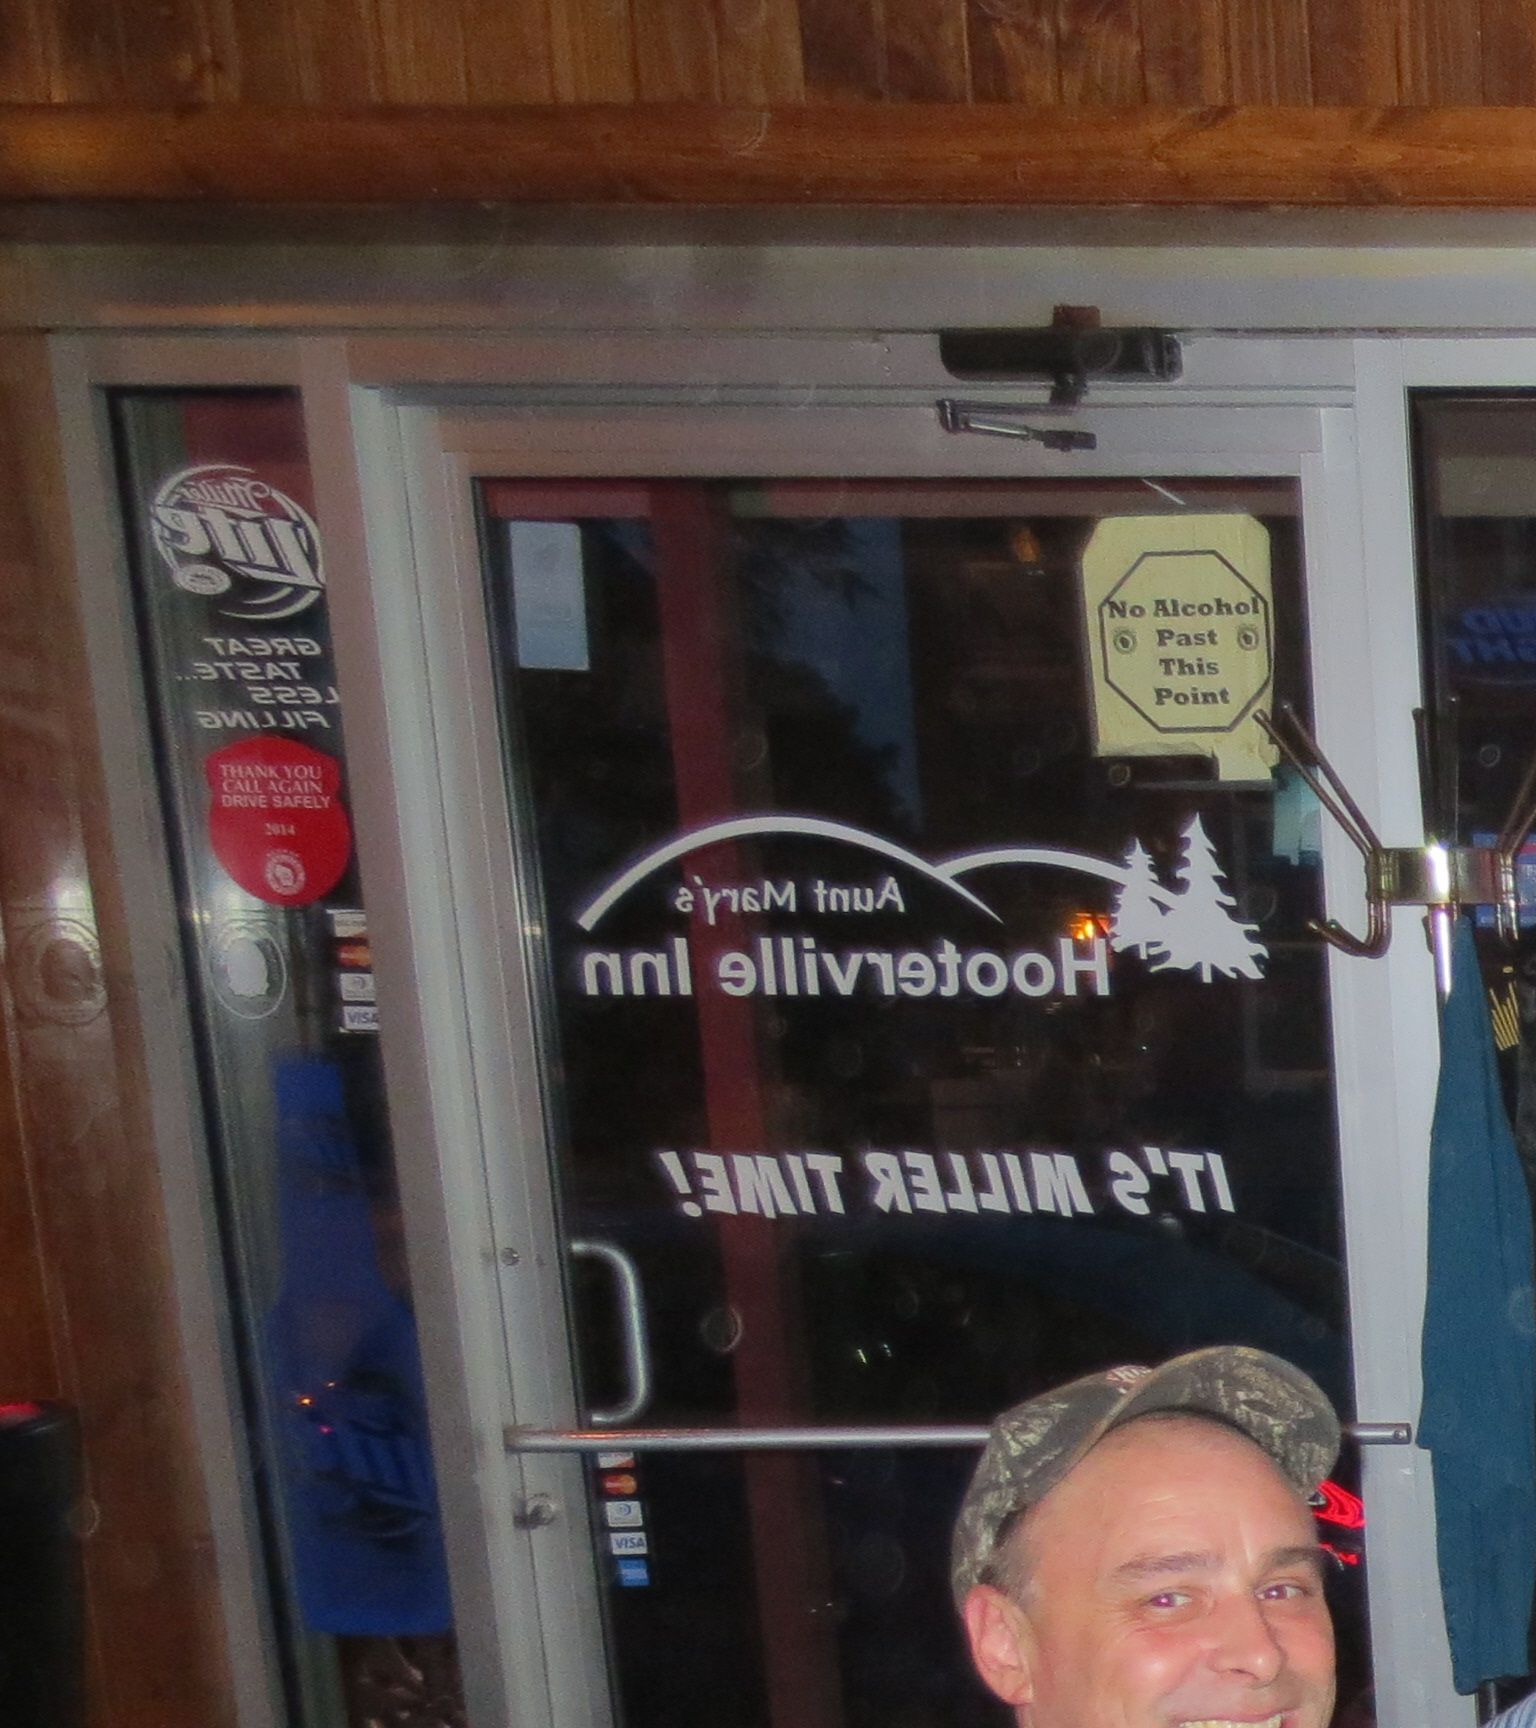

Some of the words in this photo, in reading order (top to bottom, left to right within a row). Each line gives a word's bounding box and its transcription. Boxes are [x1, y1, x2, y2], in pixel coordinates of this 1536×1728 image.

[1108, 601, 1146, 618] No
[1153, 597, 1260, 617] Alcohol
[1156, 629, 1218, 647] Past
[1158, 658, 1219, 676] This
[1154, 687, 1231, 706] Point
[219, 764, 279, 779] THANK
[282, 765, 322, 780] YOU
[222, 779, 262, 794] CALL
[268, 780, 323, 794] AGAIN
[222, 795, 268, 808] DRIVE
[272, 795, 331, 809] SAFELY
[615, 1537, 646, 1550] VISA
